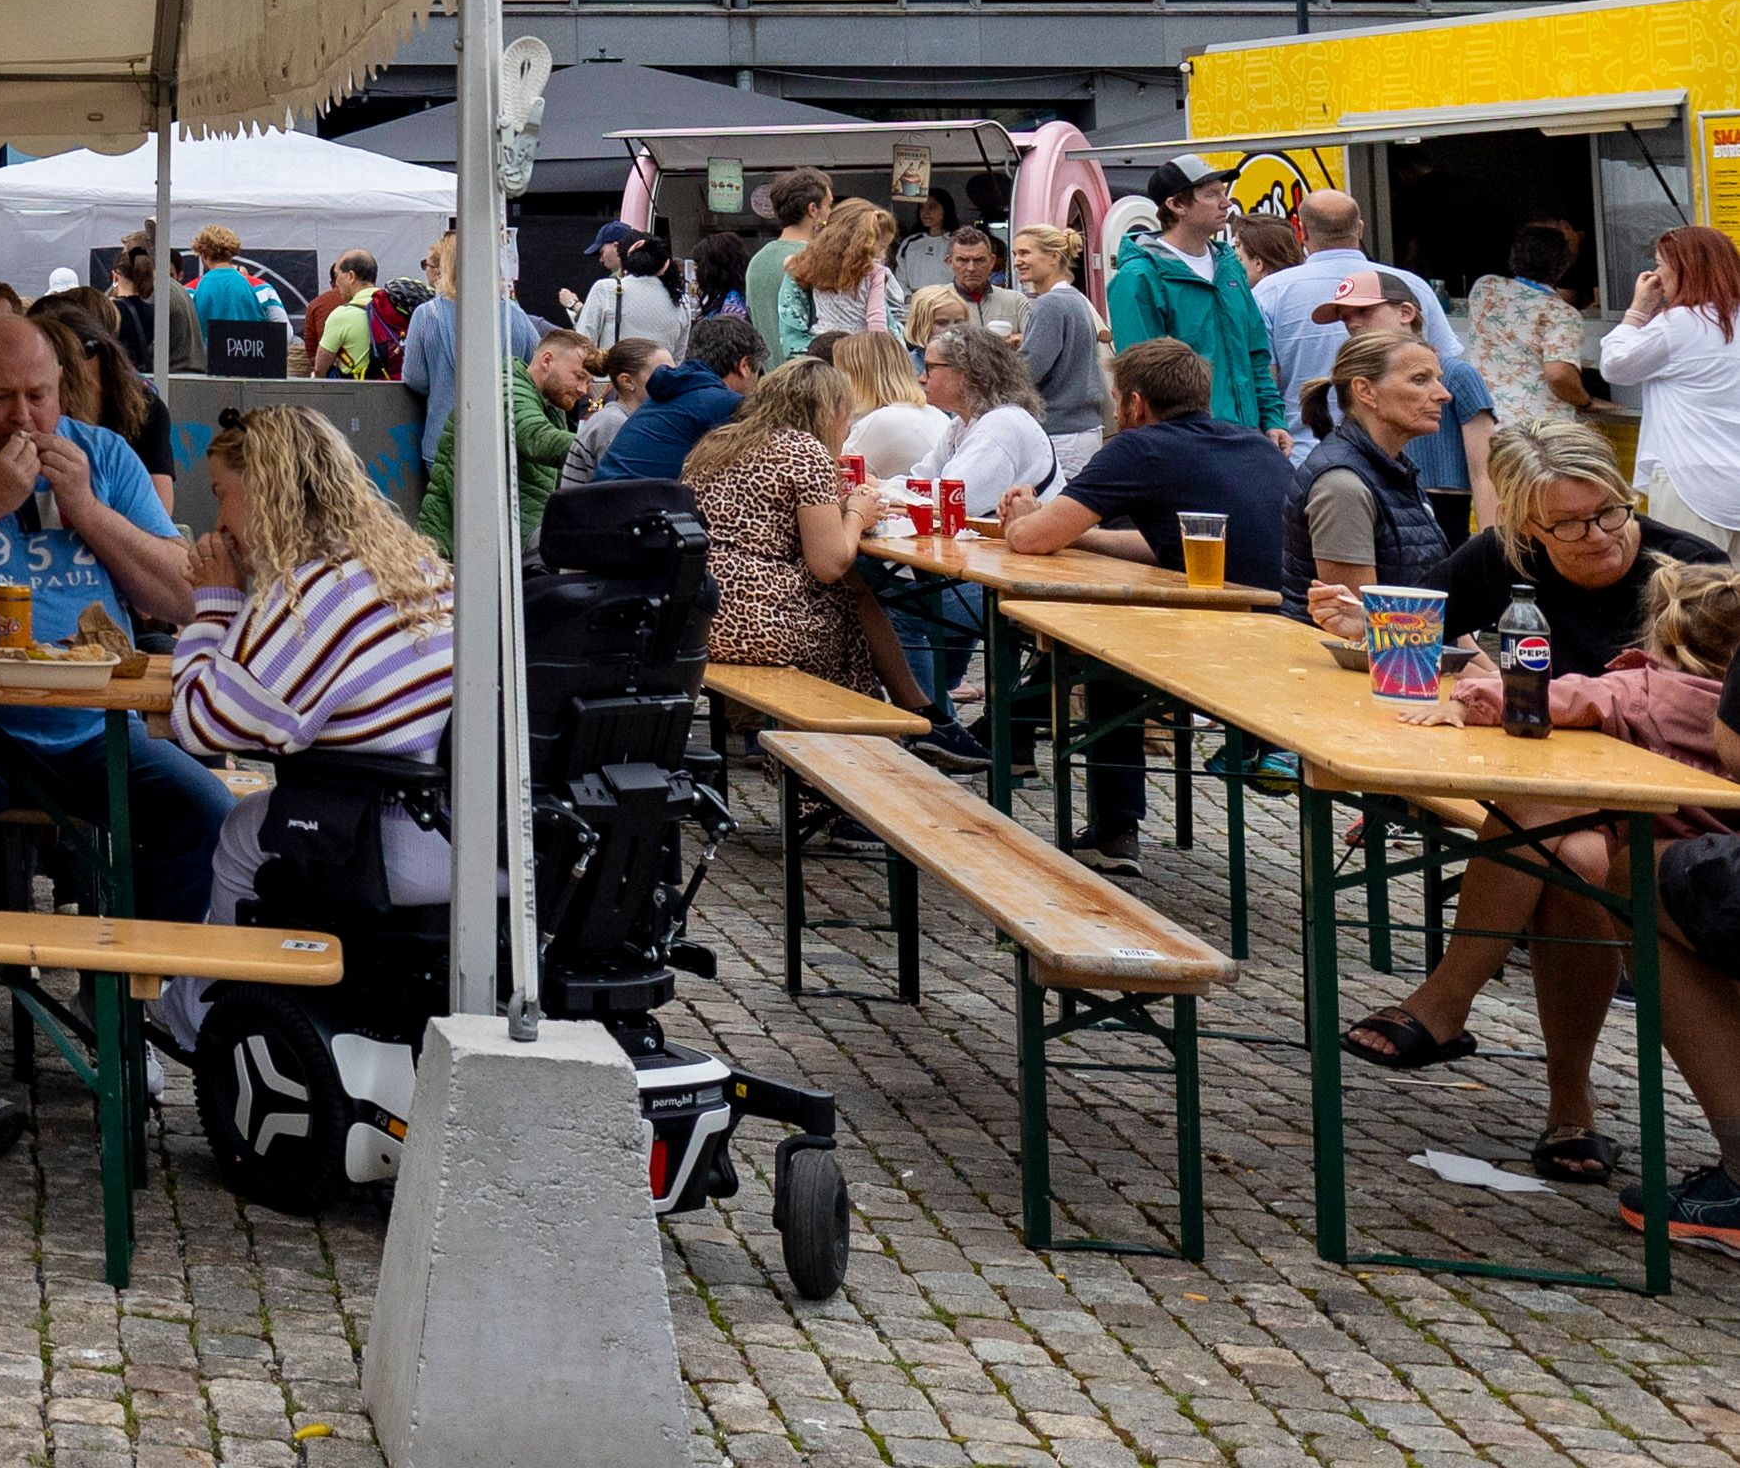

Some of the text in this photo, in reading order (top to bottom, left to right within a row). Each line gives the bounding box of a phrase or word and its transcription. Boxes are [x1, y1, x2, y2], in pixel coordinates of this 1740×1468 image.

[226, 337, 265, 359] PAPIR
[29, 570, 99, 589] PAUL
[652, 1093, 693, 1110] permobil
